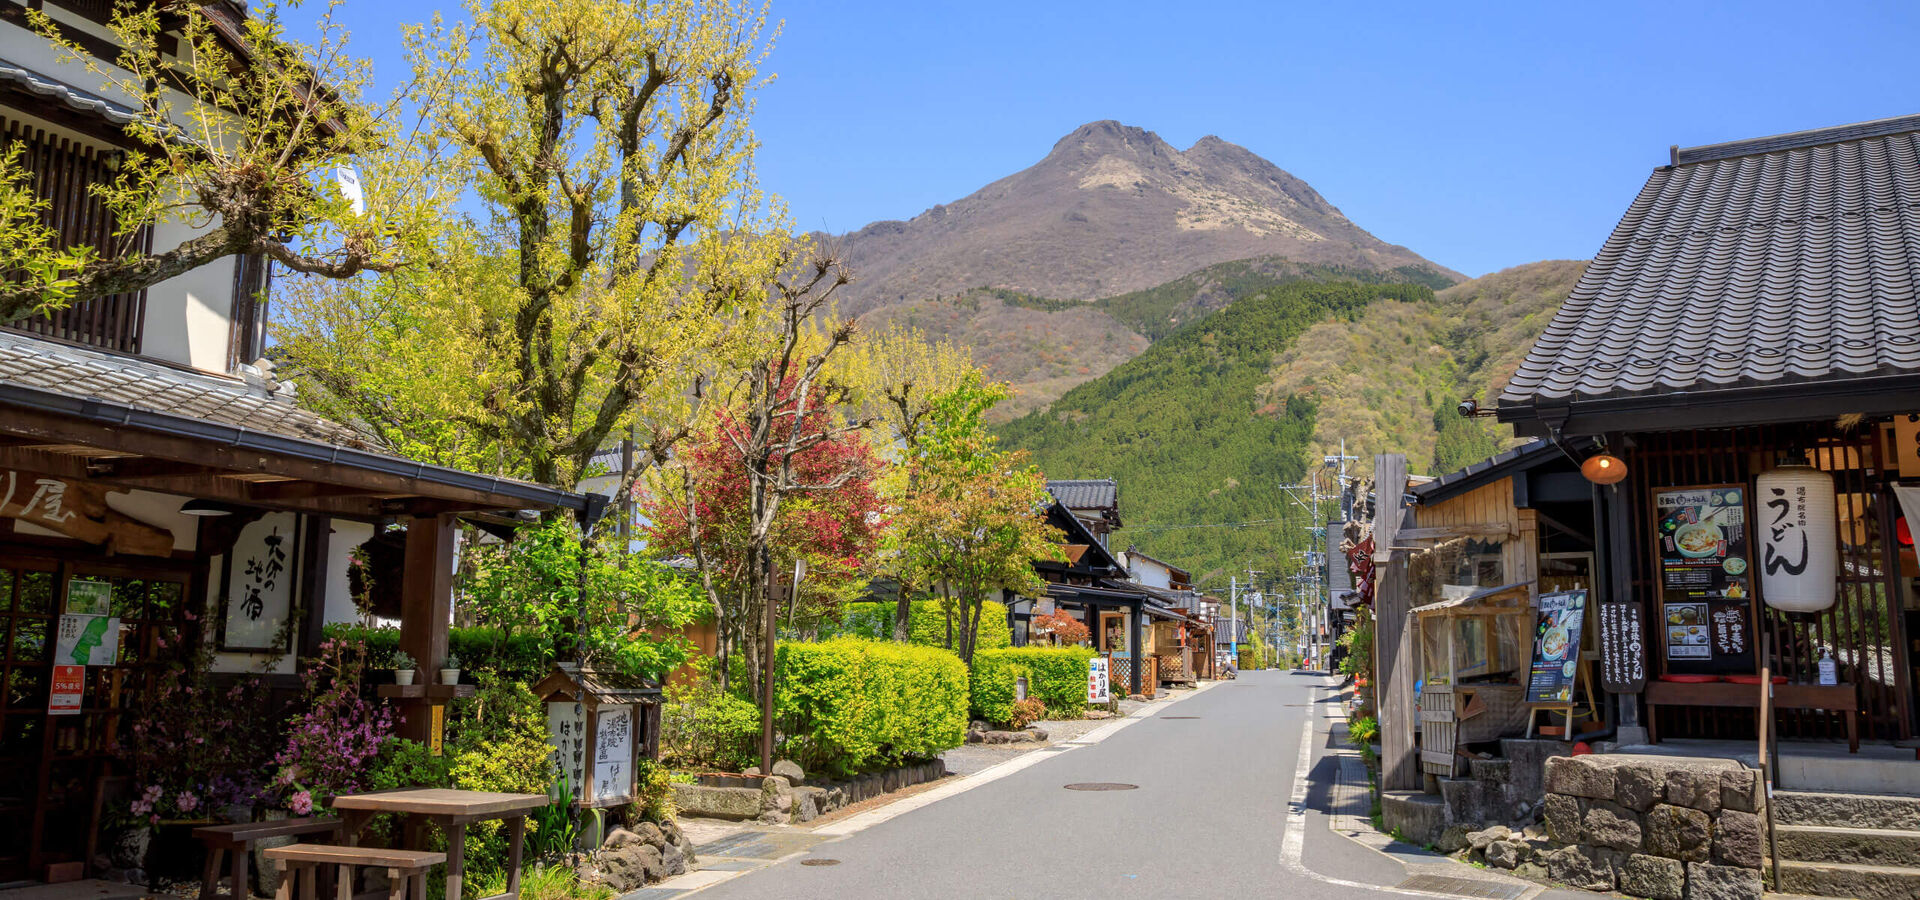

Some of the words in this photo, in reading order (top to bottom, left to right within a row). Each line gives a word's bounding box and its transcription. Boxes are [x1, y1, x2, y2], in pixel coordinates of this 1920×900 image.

[264, 526, 286, 592] 大分の
[1764, 487, 1808, 576] うどん
[240, 556, 264, 621] 地酒
[1098, 663, 1107, 698] はかり屋
